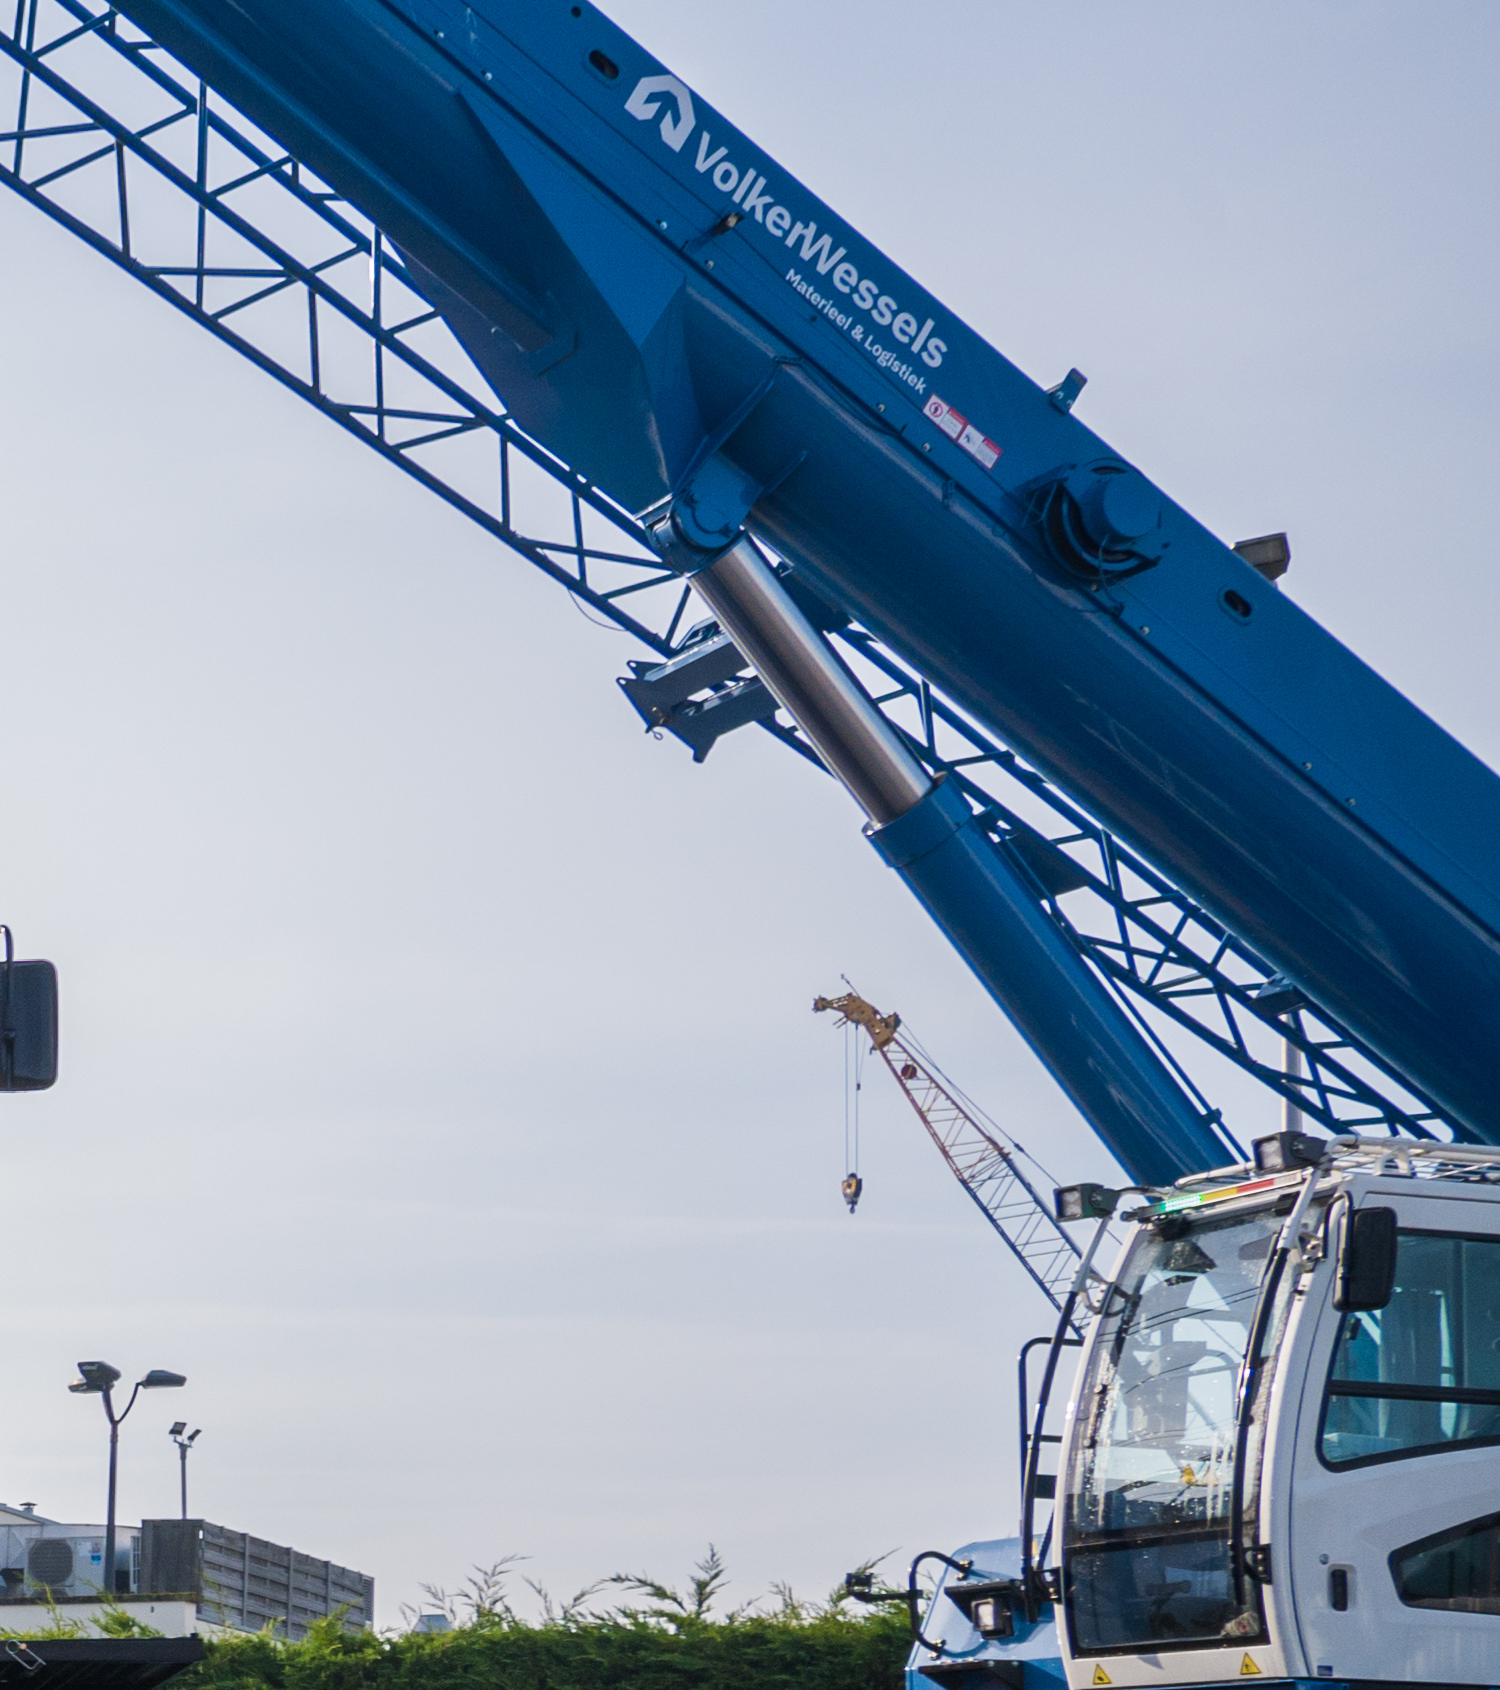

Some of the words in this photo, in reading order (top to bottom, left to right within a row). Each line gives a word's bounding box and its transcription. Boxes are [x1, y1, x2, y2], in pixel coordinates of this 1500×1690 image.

[694, 130, 949, 369] VolkerWessels
[785, 268, 854, 331] Materieel
[850, 323, 865, 342] &
[863, 334, 928, 395] Logistiek
